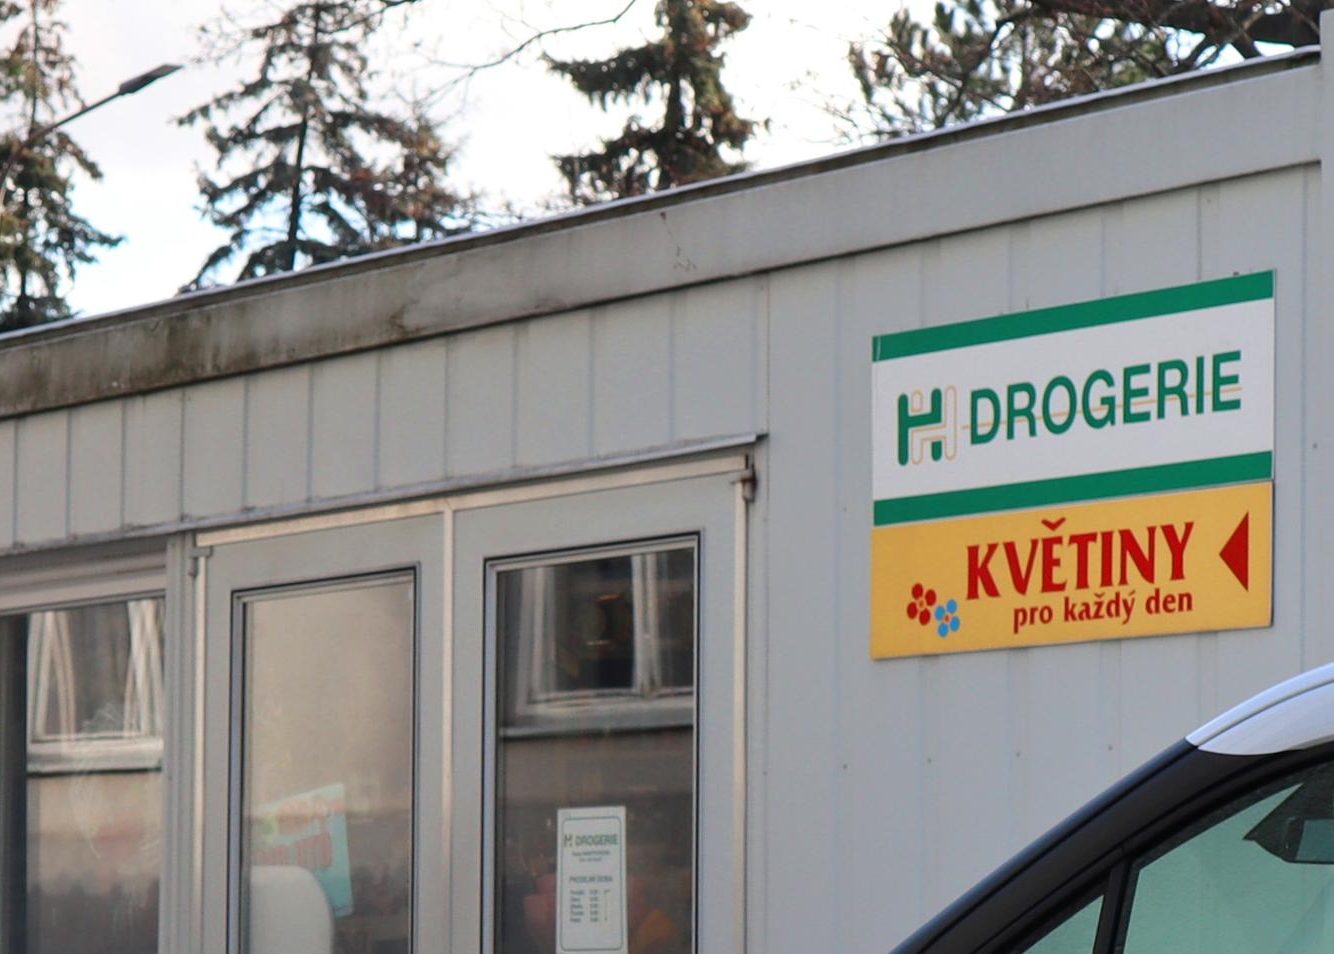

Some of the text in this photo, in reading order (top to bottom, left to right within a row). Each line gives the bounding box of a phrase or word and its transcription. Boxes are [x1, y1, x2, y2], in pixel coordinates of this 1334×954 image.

[970, 350, 1242, 445] DROGERIE
[966, 517, 1195, 600] KVĚTINY
[1013, 587, 1193, 634] pro každý den
[575, 833, 619, 847] DROGERIE
